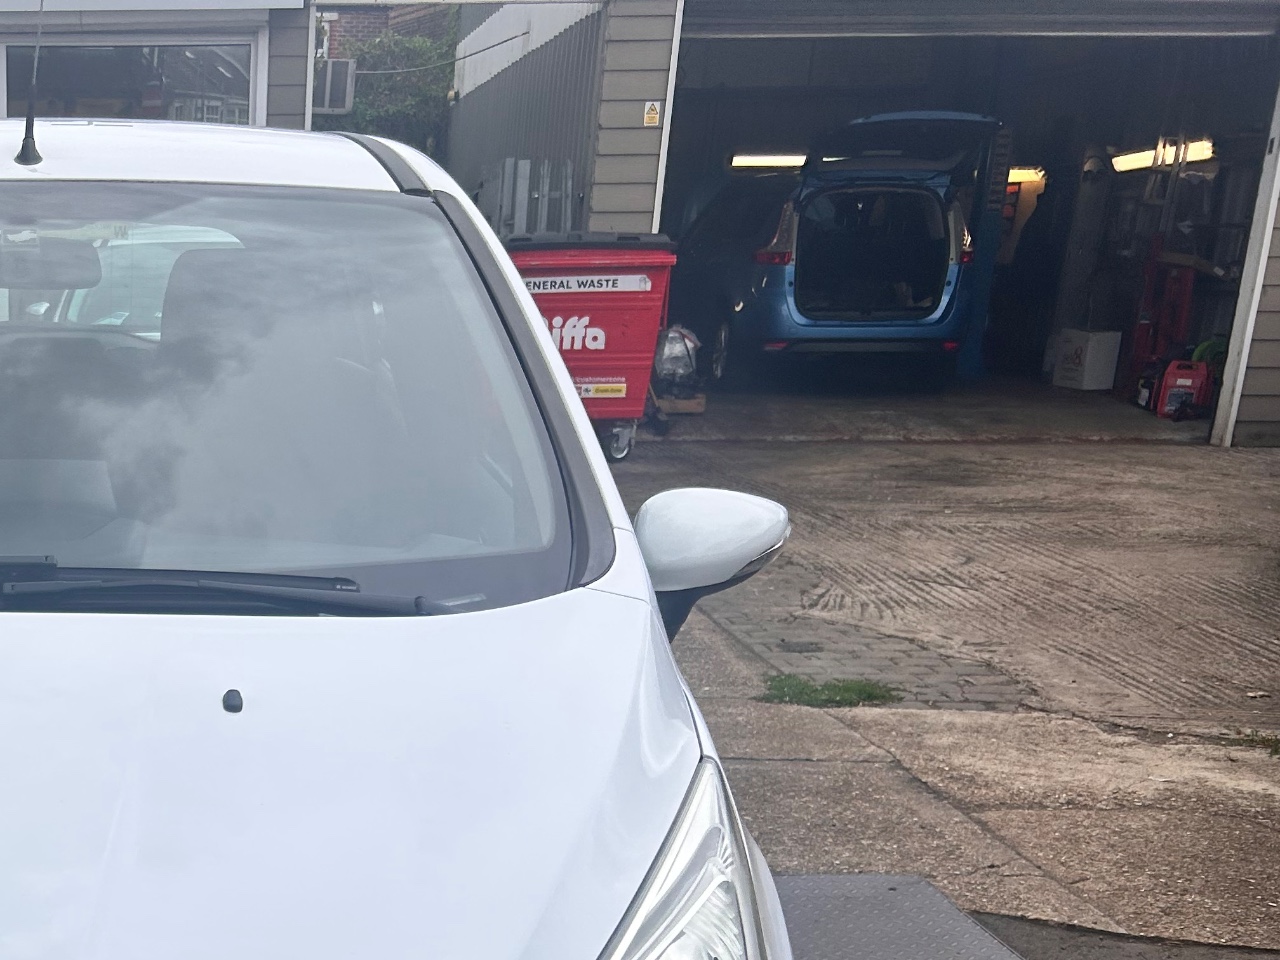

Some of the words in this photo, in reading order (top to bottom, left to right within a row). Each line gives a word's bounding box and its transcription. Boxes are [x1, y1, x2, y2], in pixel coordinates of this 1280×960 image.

[526, 279, 573, 290] ENERAL
[577, 278, 619, 289] WASTE
[544, 316, 606, 350] iffa
